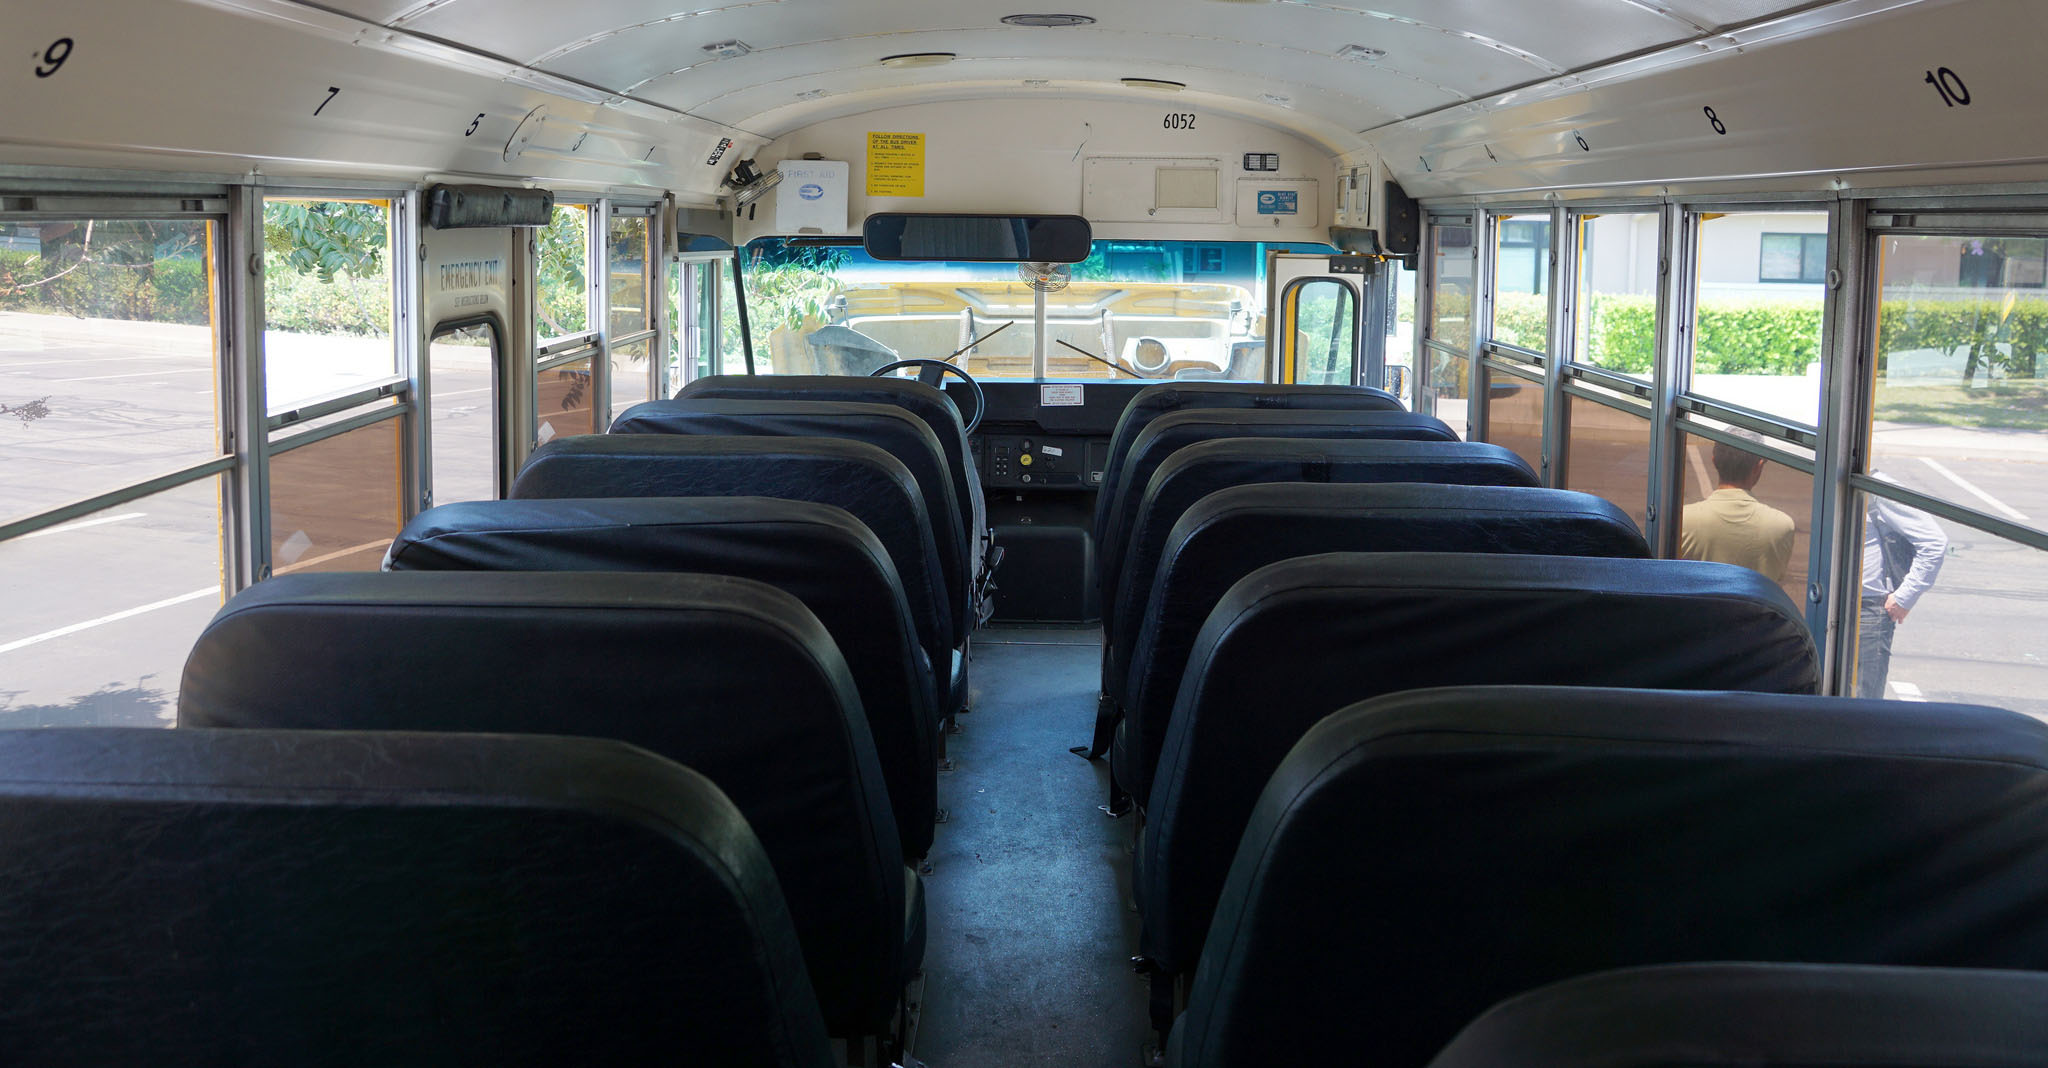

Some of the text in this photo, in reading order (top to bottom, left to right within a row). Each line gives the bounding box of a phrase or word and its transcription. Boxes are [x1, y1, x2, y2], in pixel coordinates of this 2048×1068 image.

[35, 37, 74, 78] 9
[1924, 66, 1971, 107] 10
[313, 86, 341, 117] 7
[465, 113, 486, 137] 5
[1163, 113, 1196, 130] 6052
[1703, 106, 1726, 135] 8
[1573, 128, 1590, 152] 6
[788, 169, 836, 178] FIRST AID
[440, 260, 498, 292] EMERGENCY EXIT
